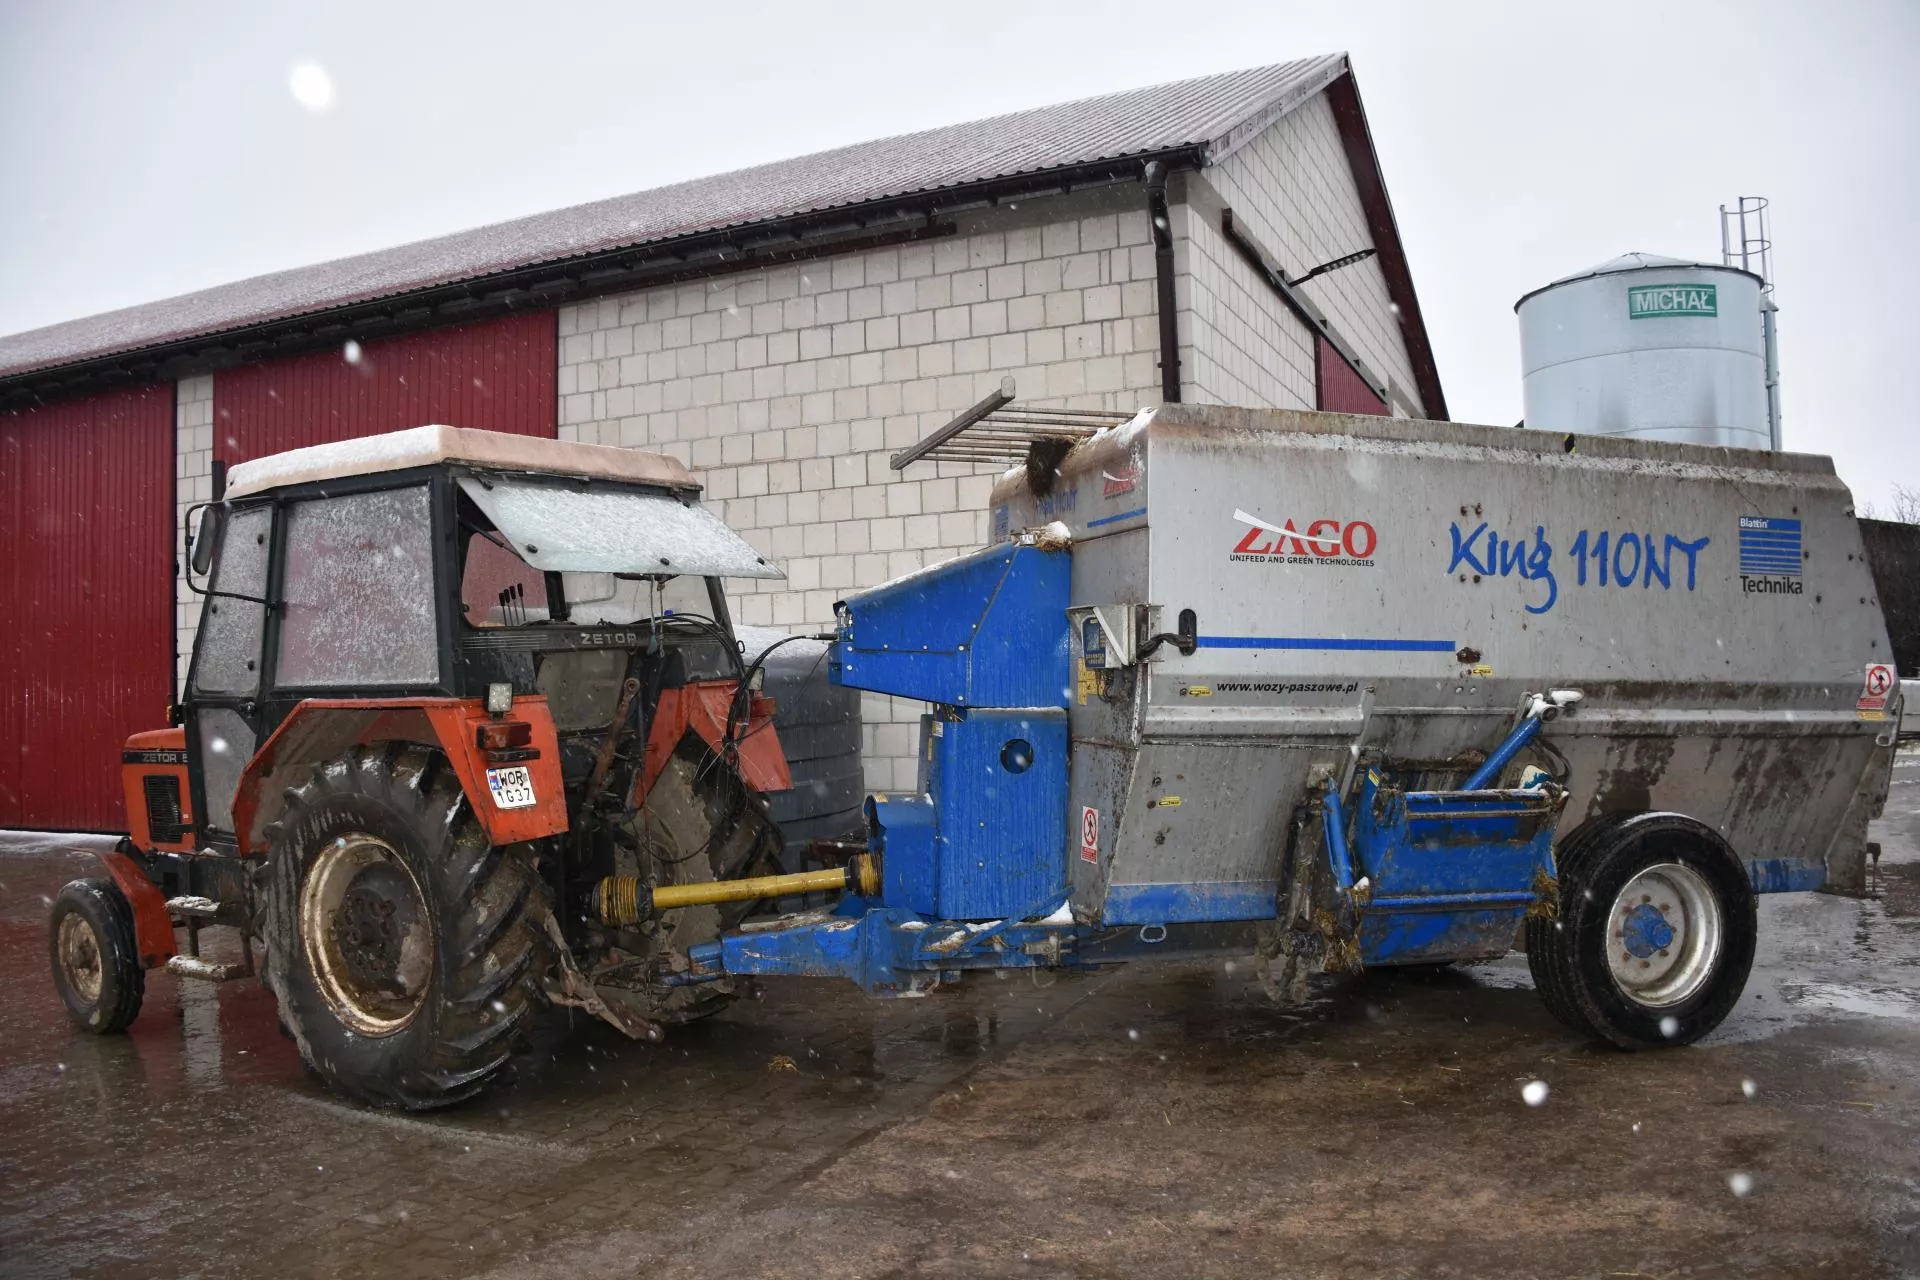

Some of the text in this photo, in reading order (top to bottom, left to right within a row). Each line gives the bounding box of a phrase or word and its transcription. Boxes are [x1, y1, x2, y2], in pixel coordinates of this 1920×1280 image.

[1635, 290, 1715, 311] MICHAŁ
[1233, 512, 1377, 559] ZAGO
[1229, 554, 1375, 567] UNIFEED AND GREEN TECHNOLOGIES
[1447, 522, 1710, 614] King 110NT
[1740, 575, 1803, 594] Technika
[580, 632, 637, 646] ZETOR
[1216, 682, 1358, 694] www.wozy-paszowe.pl
[142, 753, 177, 763] ZETOR
[498, 770, 525, 787] WOR
